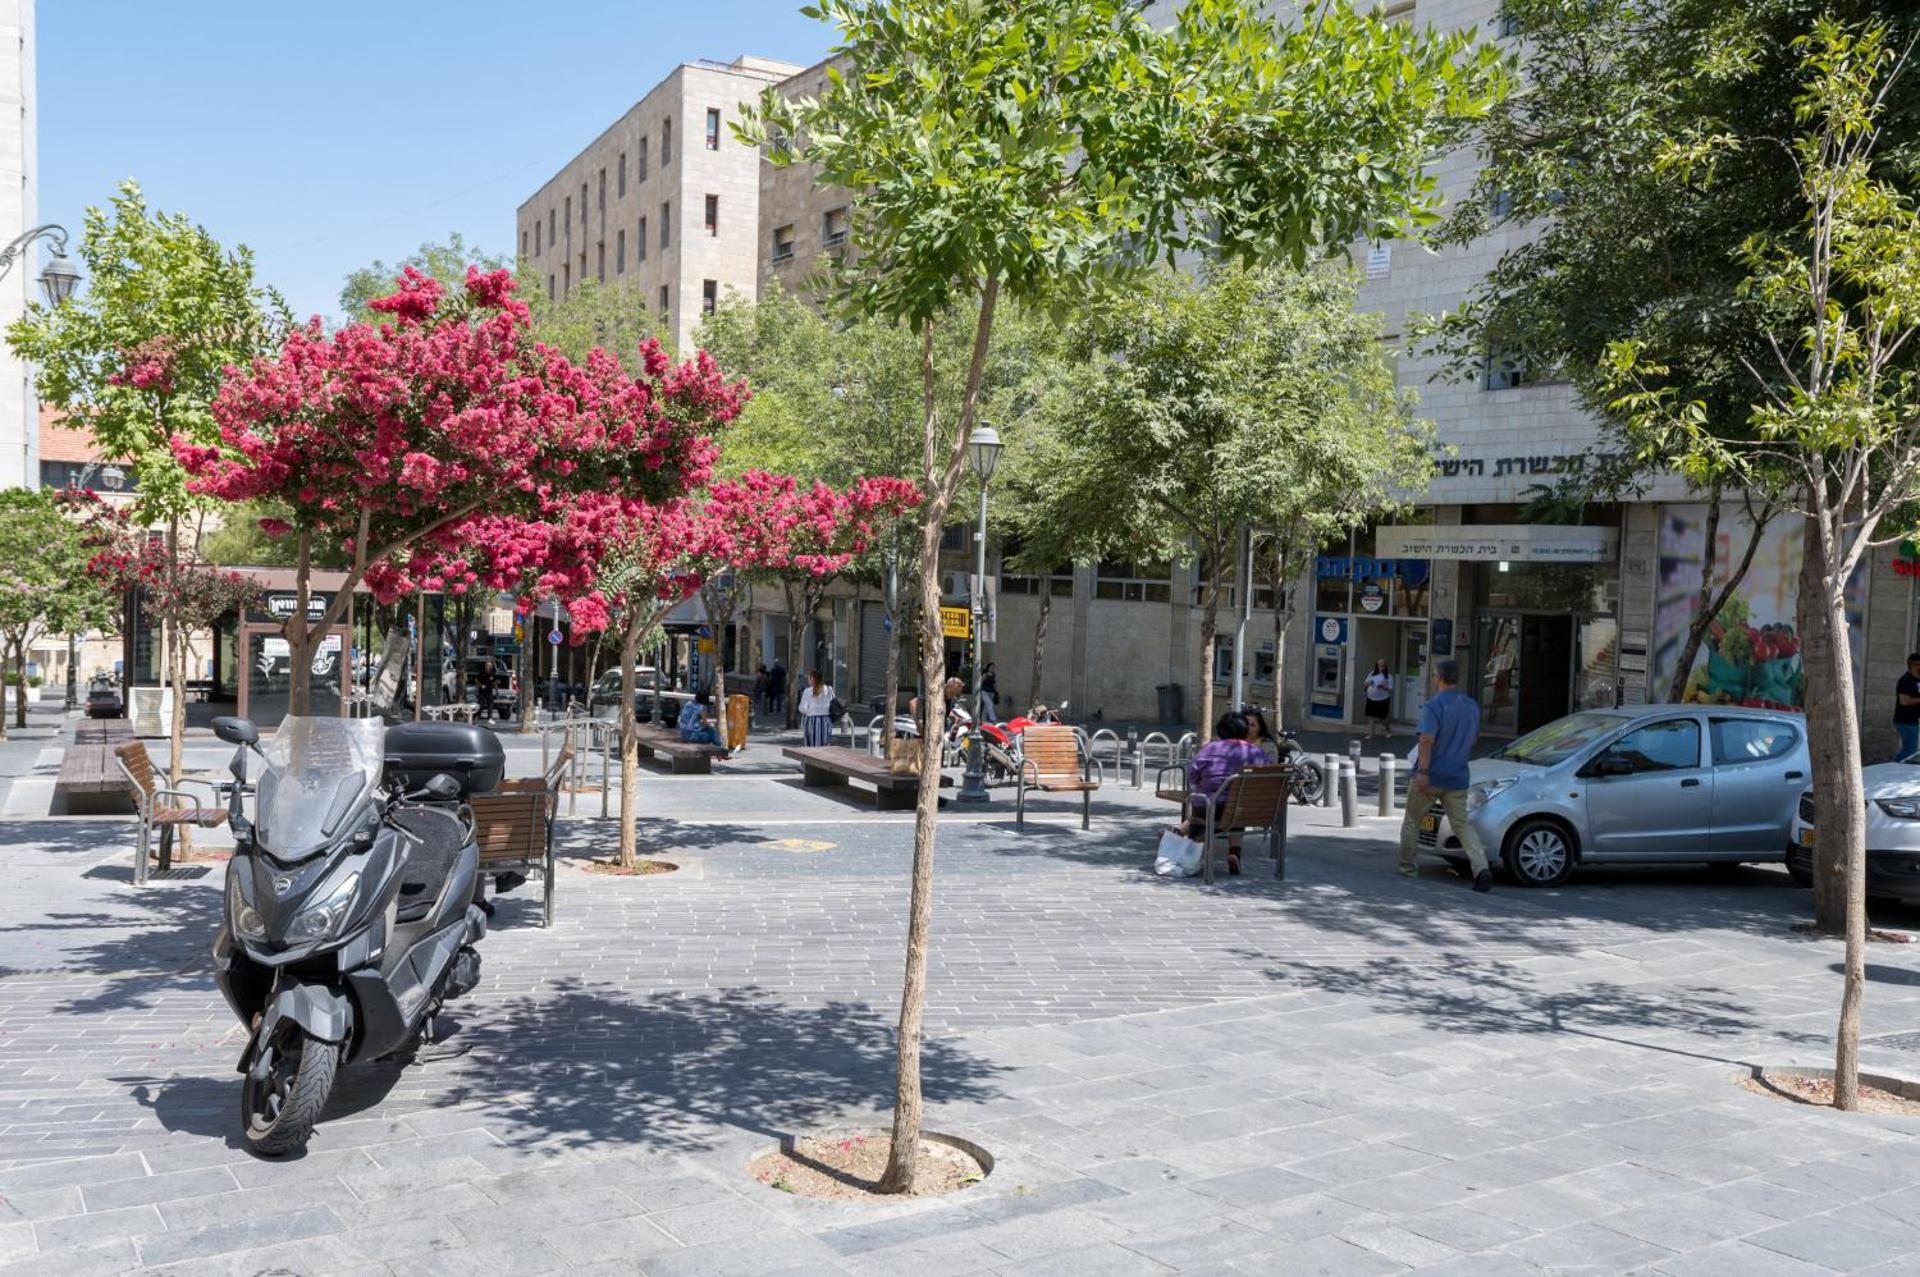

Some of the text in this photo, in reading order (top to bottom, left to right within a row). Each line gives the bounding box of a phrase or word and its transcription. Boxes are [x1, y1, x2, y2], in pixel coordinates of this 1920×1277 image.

[1402, 544, 1497, 555] בית הכשרת הישוב
